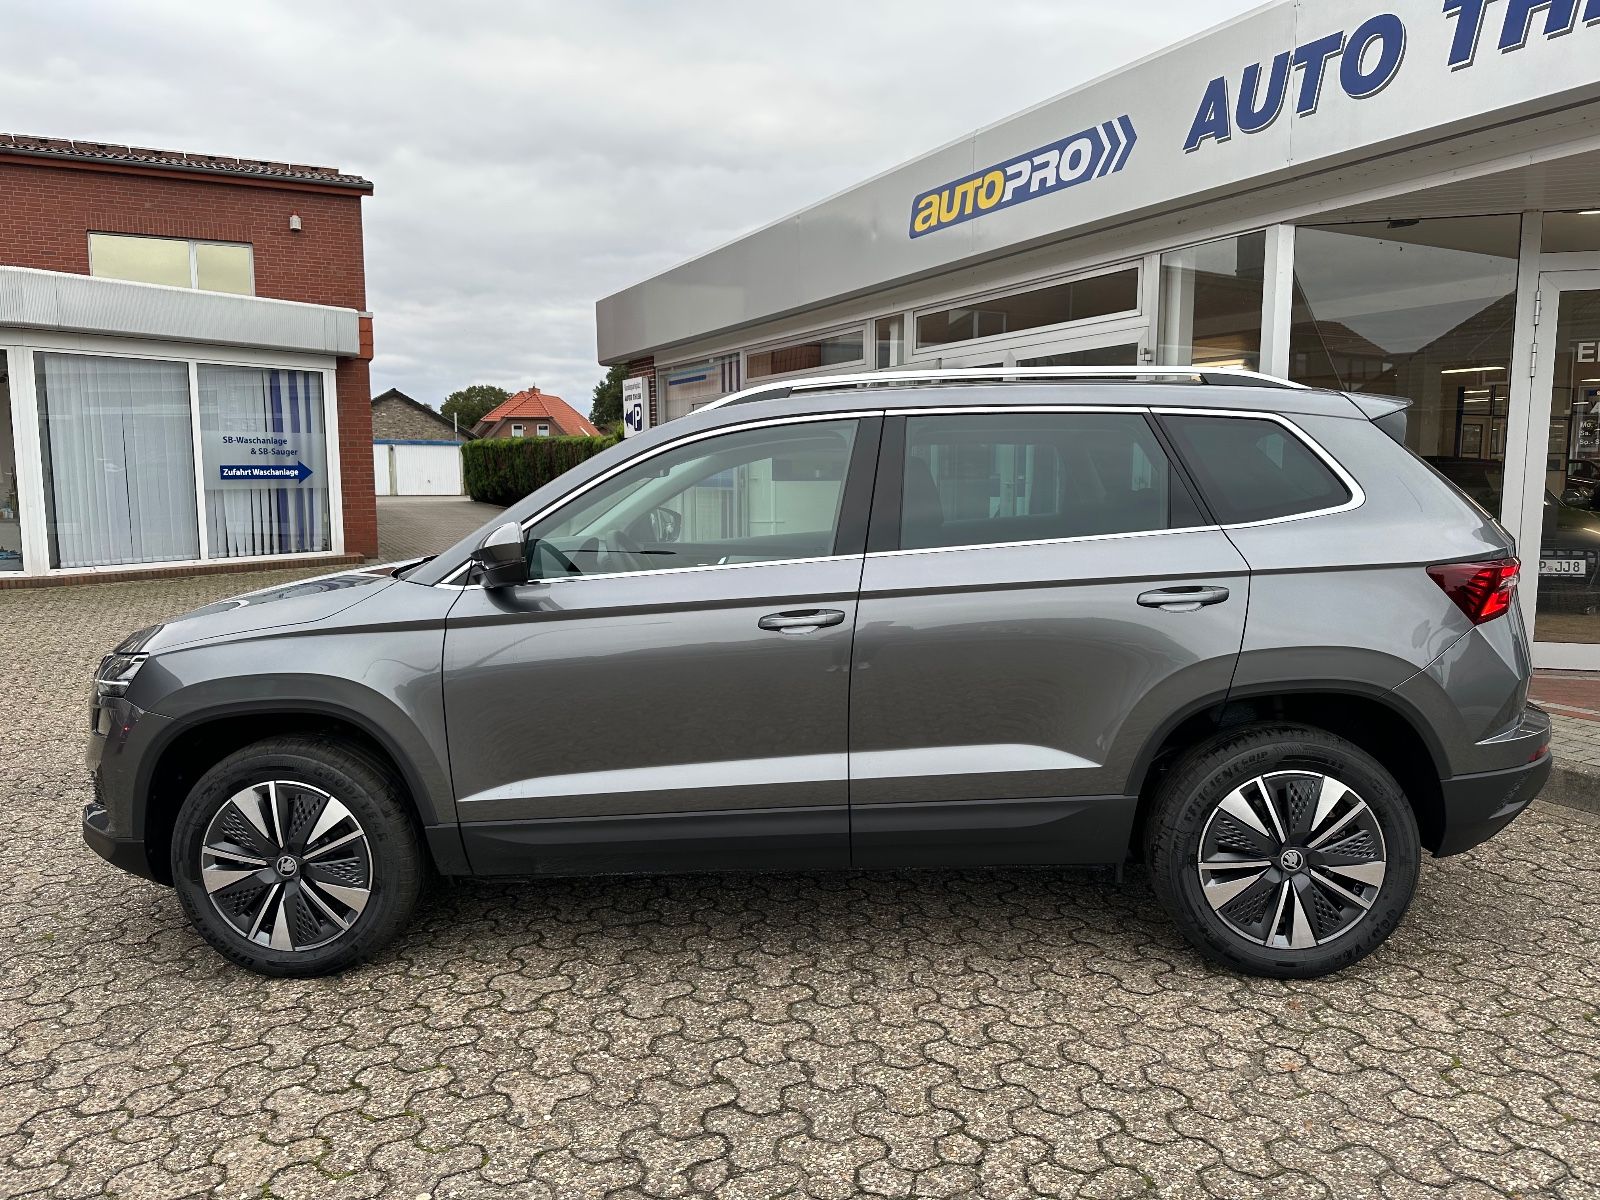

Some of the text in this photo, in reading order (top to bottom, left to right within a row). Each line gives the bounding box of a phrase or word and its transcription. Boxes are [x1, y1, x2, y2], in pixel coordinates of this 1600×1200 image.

[1183, 0, 1600, 154] AUTO TH
[222, 436, 288, 446] SB-Waschanlage
[258, 448, 298, 457] SB-Sauger
[222, 468, 299, 477] Zufahrt Waschanlage
